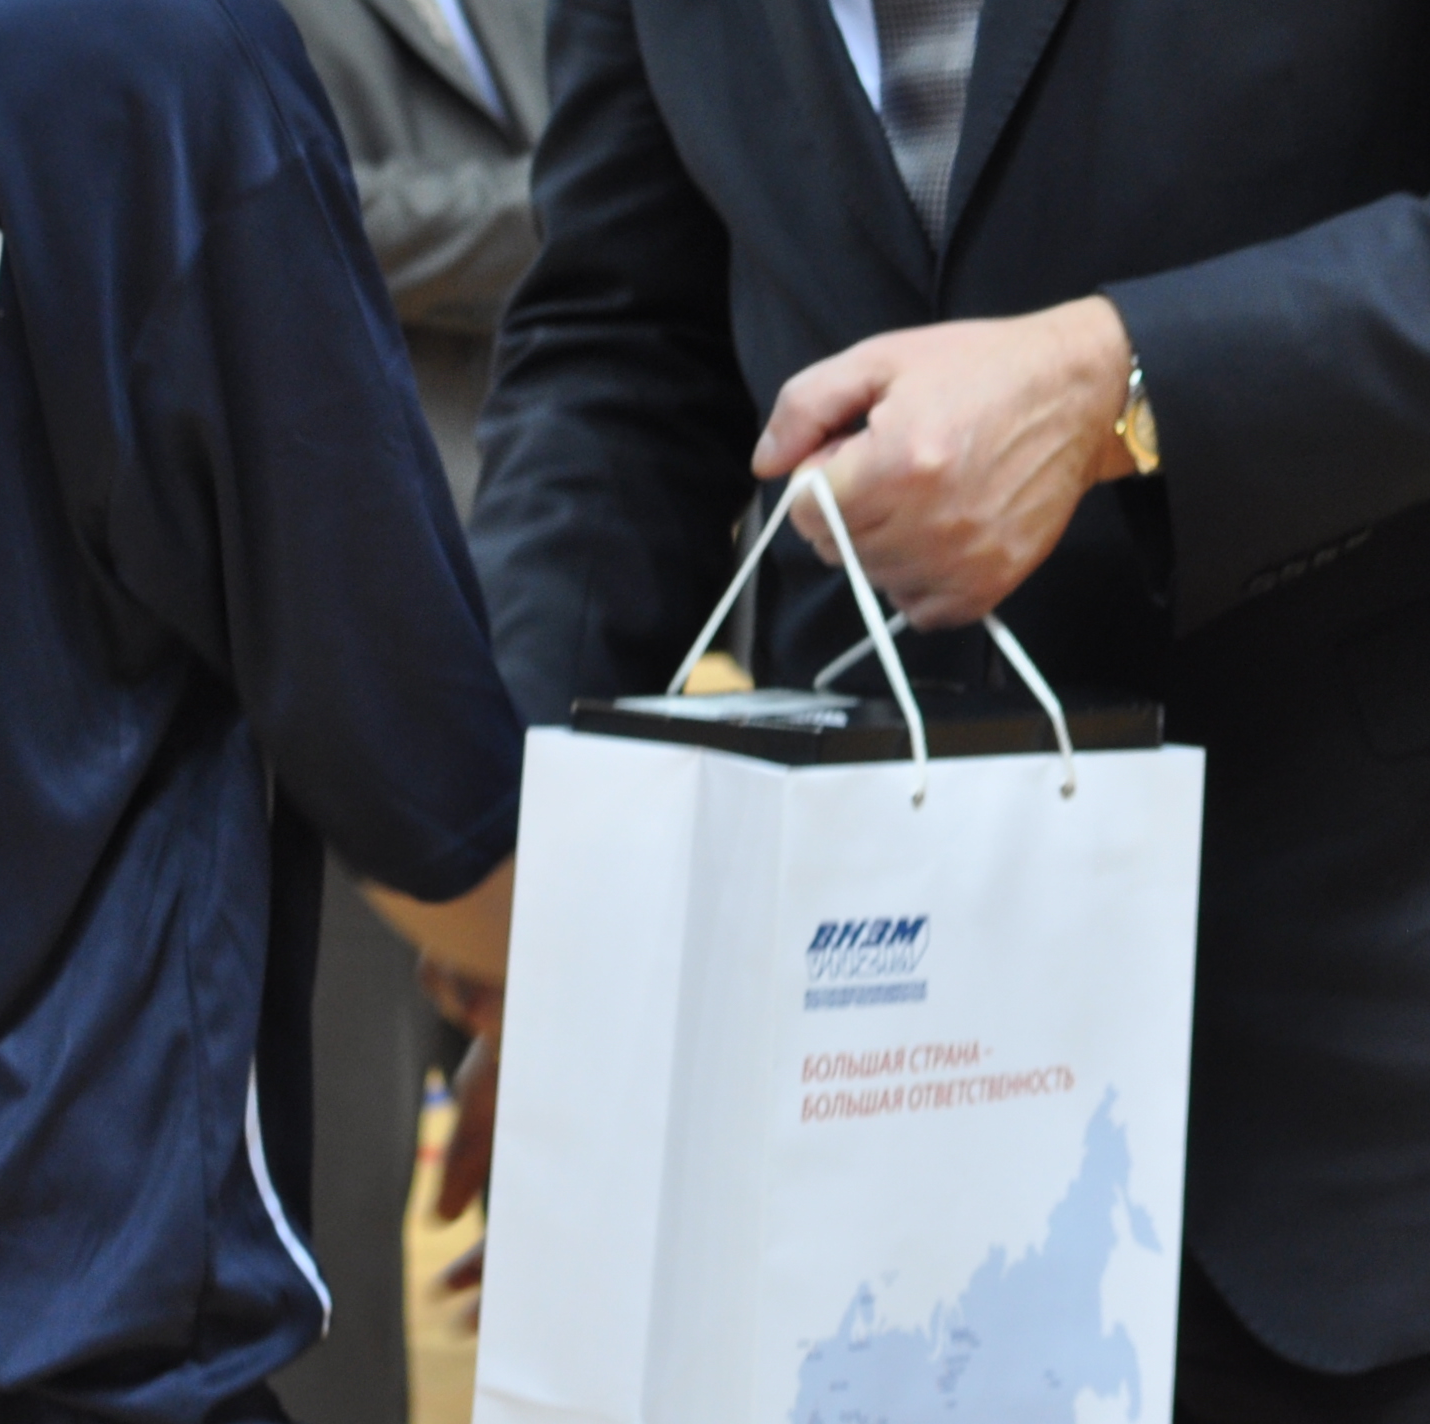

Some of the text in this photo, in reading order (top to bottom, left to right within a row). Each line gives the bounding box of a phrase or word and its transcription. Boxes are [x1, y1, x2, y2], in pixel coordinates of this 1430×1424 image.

[802, 1044, 906, 1084] БОЛЬШАЯ
[908, 1039, 981, 1075] СТРАНА
[801, 1063, 1077, 1124] БОЛЬШАЯ ОТВЕТСТВЕННОСТЬ
